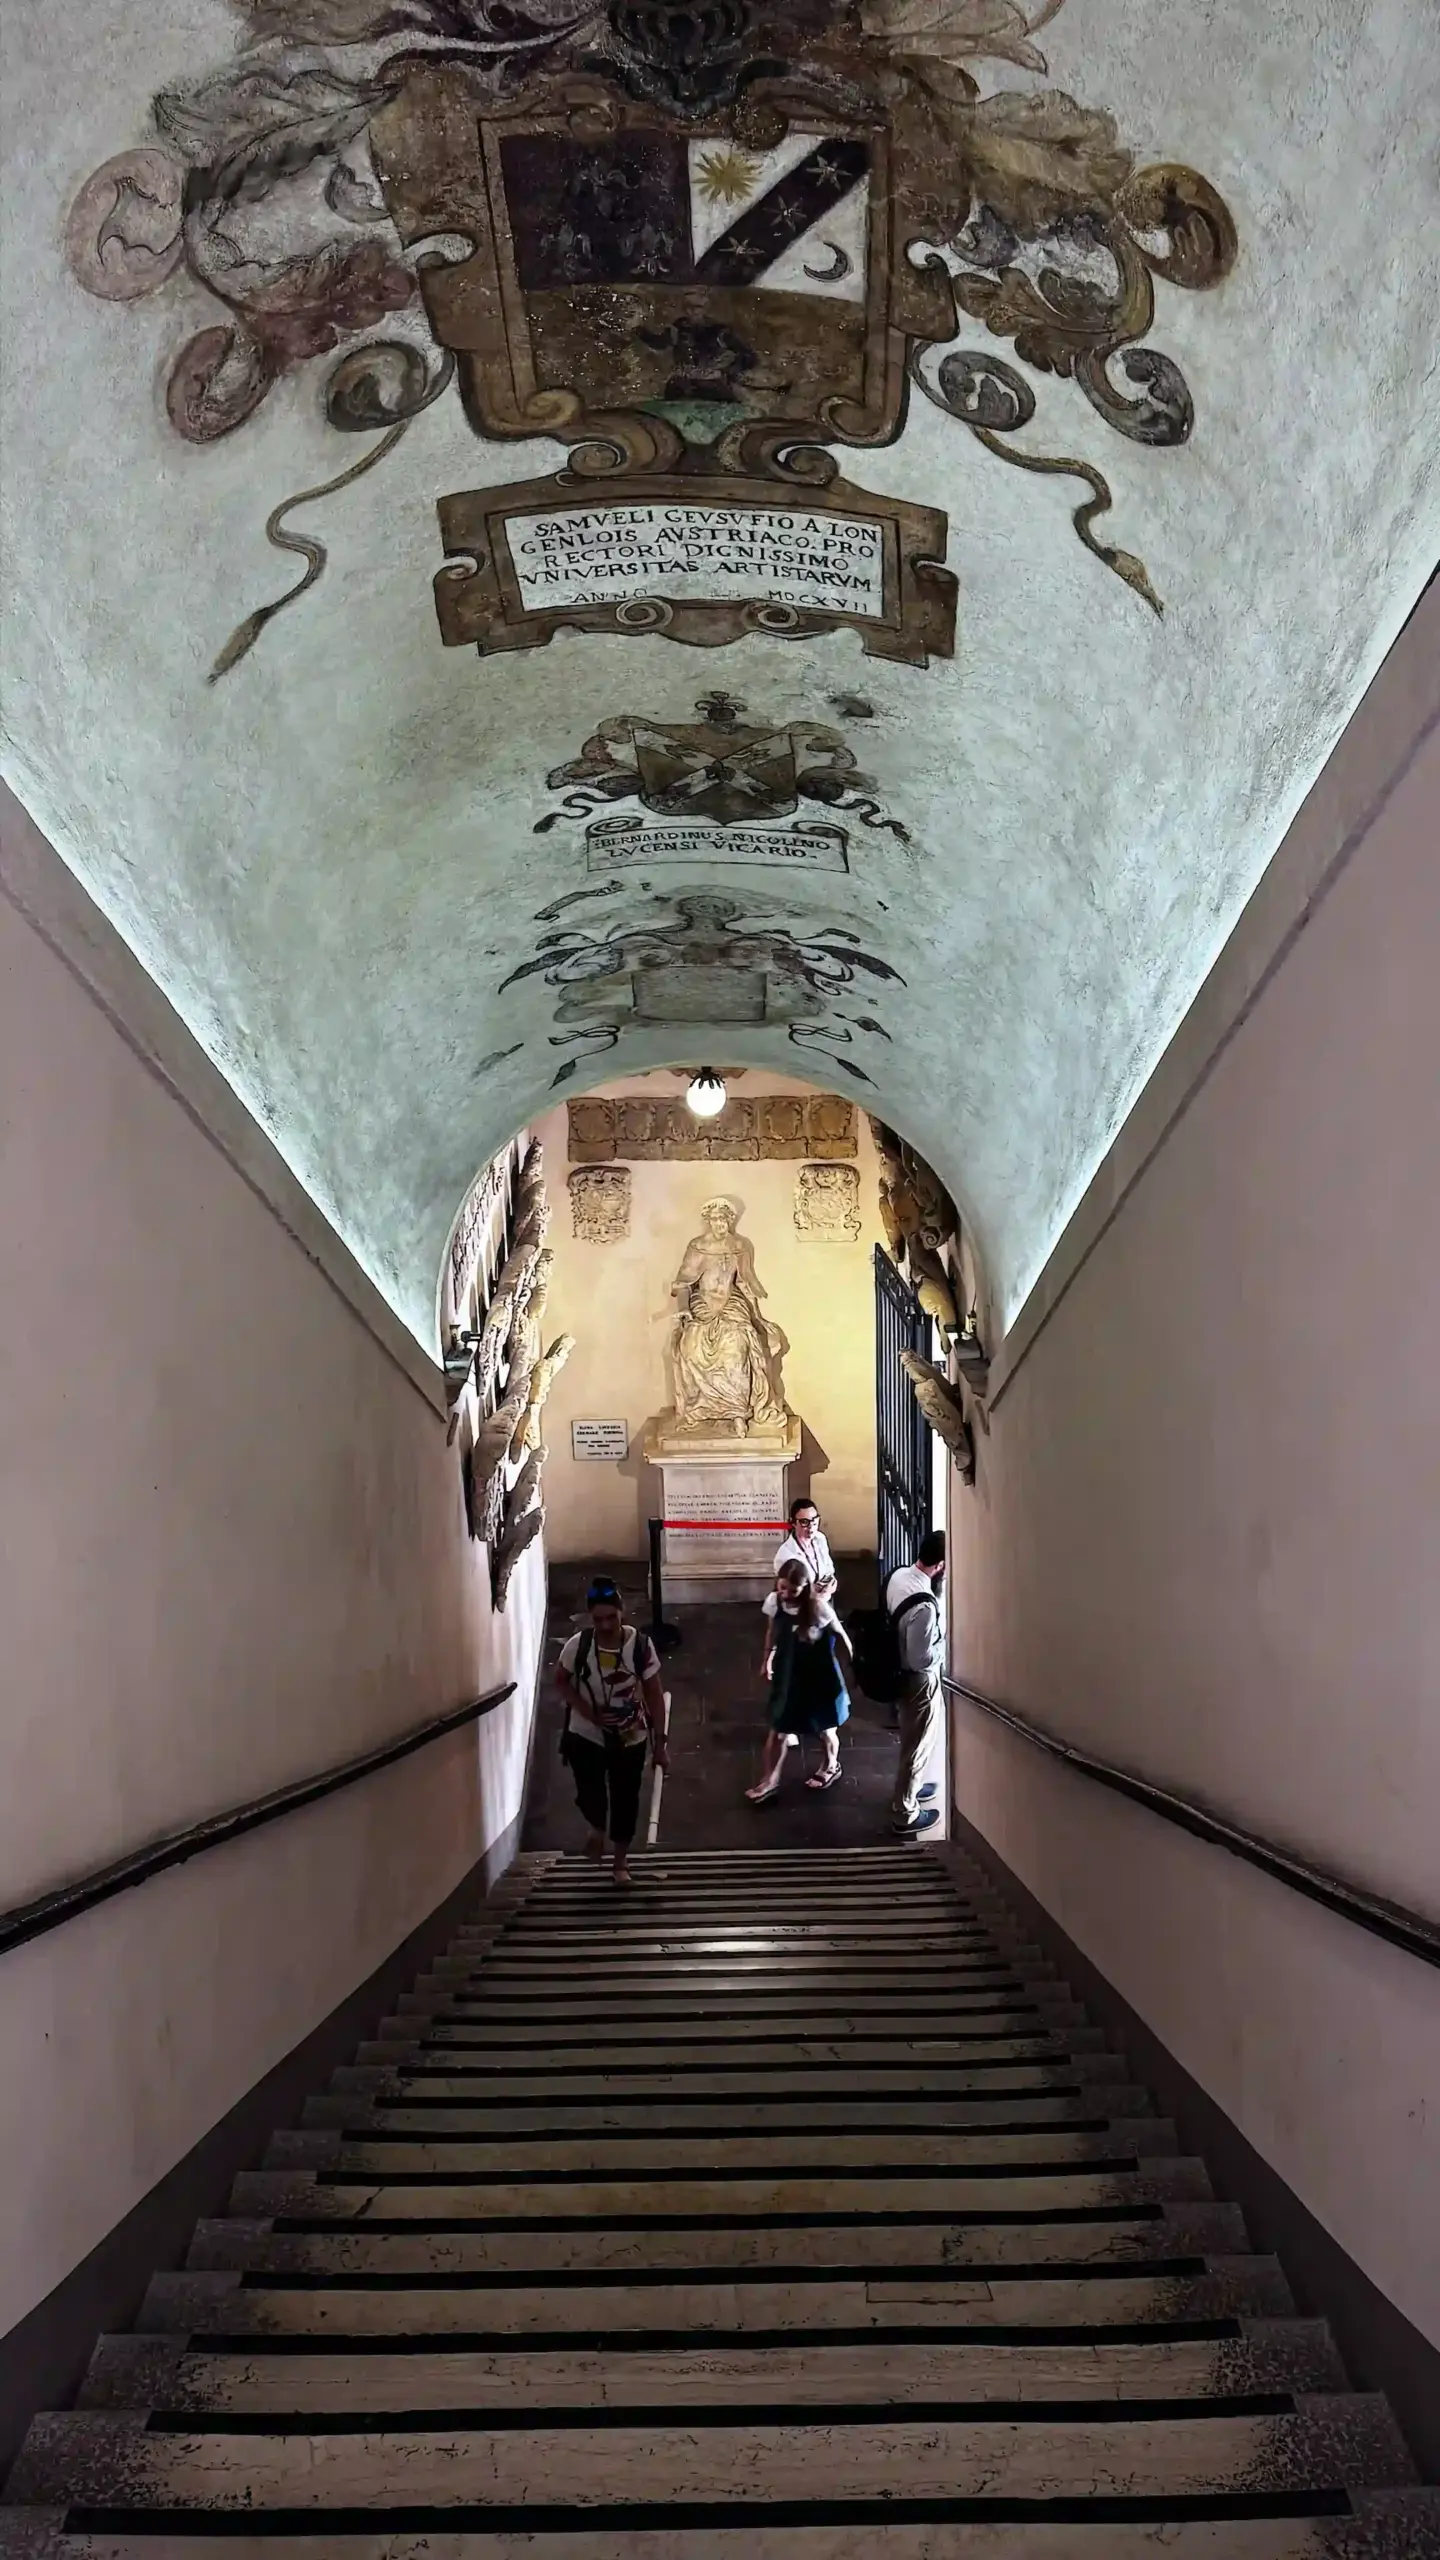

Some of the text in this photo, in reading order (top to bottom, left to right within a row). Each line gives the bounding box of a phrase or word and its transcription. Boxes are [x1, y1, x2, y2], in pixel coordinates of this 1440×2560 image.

[535, 510, 654, 537] SAMVELI
[802, 518, 821, 533] A
[828, 522, 878, 543] LON
[521, 529, 638, 554] GENLOIS
[823, 538, 874, 558] PRO
[544, 543, 849, 571] RECTORI DIGNISSIMO
[519, 558, 699, 585] VNIVERSITAS
[768, 589, 868, 613] MDCXVII
[605, 840, 699, 858] LVCENSI
